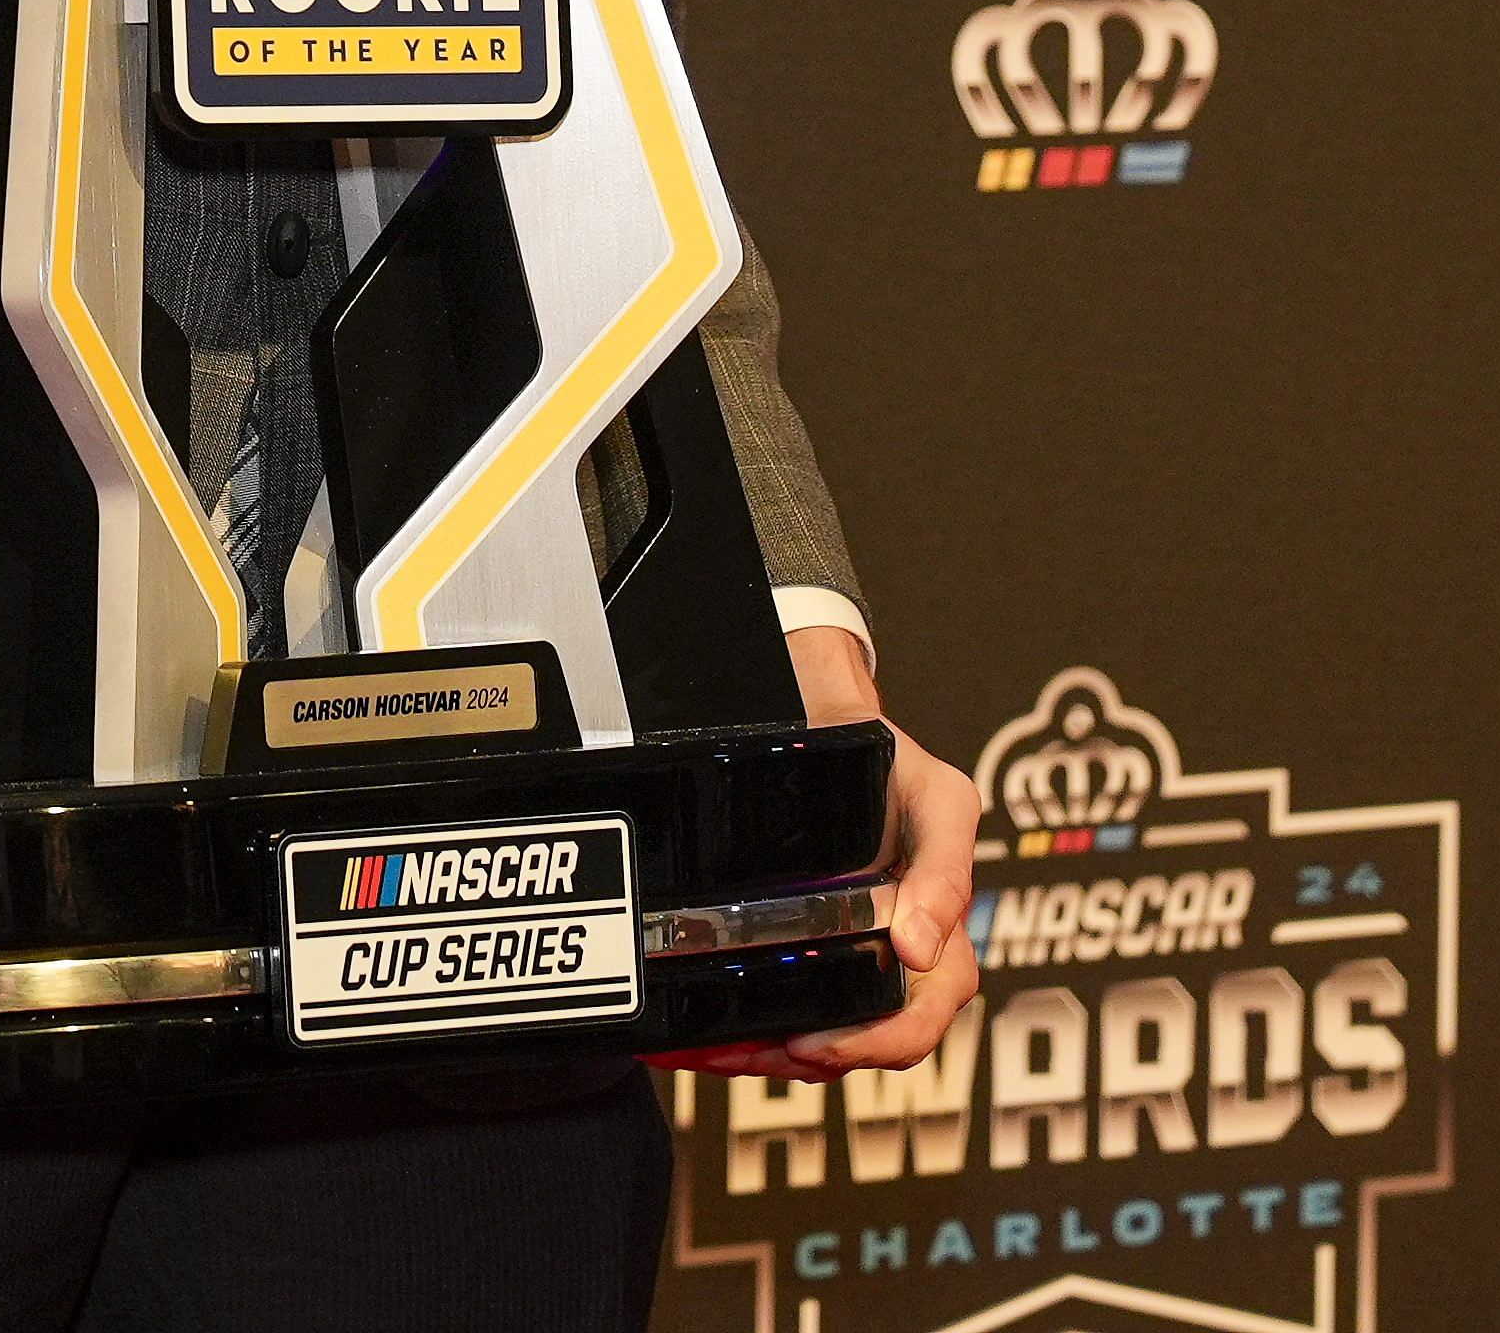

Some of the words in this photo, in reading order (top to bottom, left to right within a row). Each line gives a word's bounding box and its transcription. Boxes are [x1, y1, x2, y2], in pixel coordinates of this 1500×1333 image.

[229, 39, 276, 63] OF
[302, 39, 373, 63] THE
[404, 38, 507, 62] YEAR
[293, 696, 370, 724] CARSON
[375, 689, 462, 717] HOCEVAR
[466, 686, 509, 710] 2024
[398, 840, 580, 906] NASCAR
[985, 868, 1257, 969] NASCAR
[1295, 862, 1386, 906] 24
[341, 938, 429, 992] CUP
[435, 925, 587, 984] SERIES
[726, 957, 1408, 1197] AWARDS
[794, 1178, 1344, 1281] CHARLOTTE
